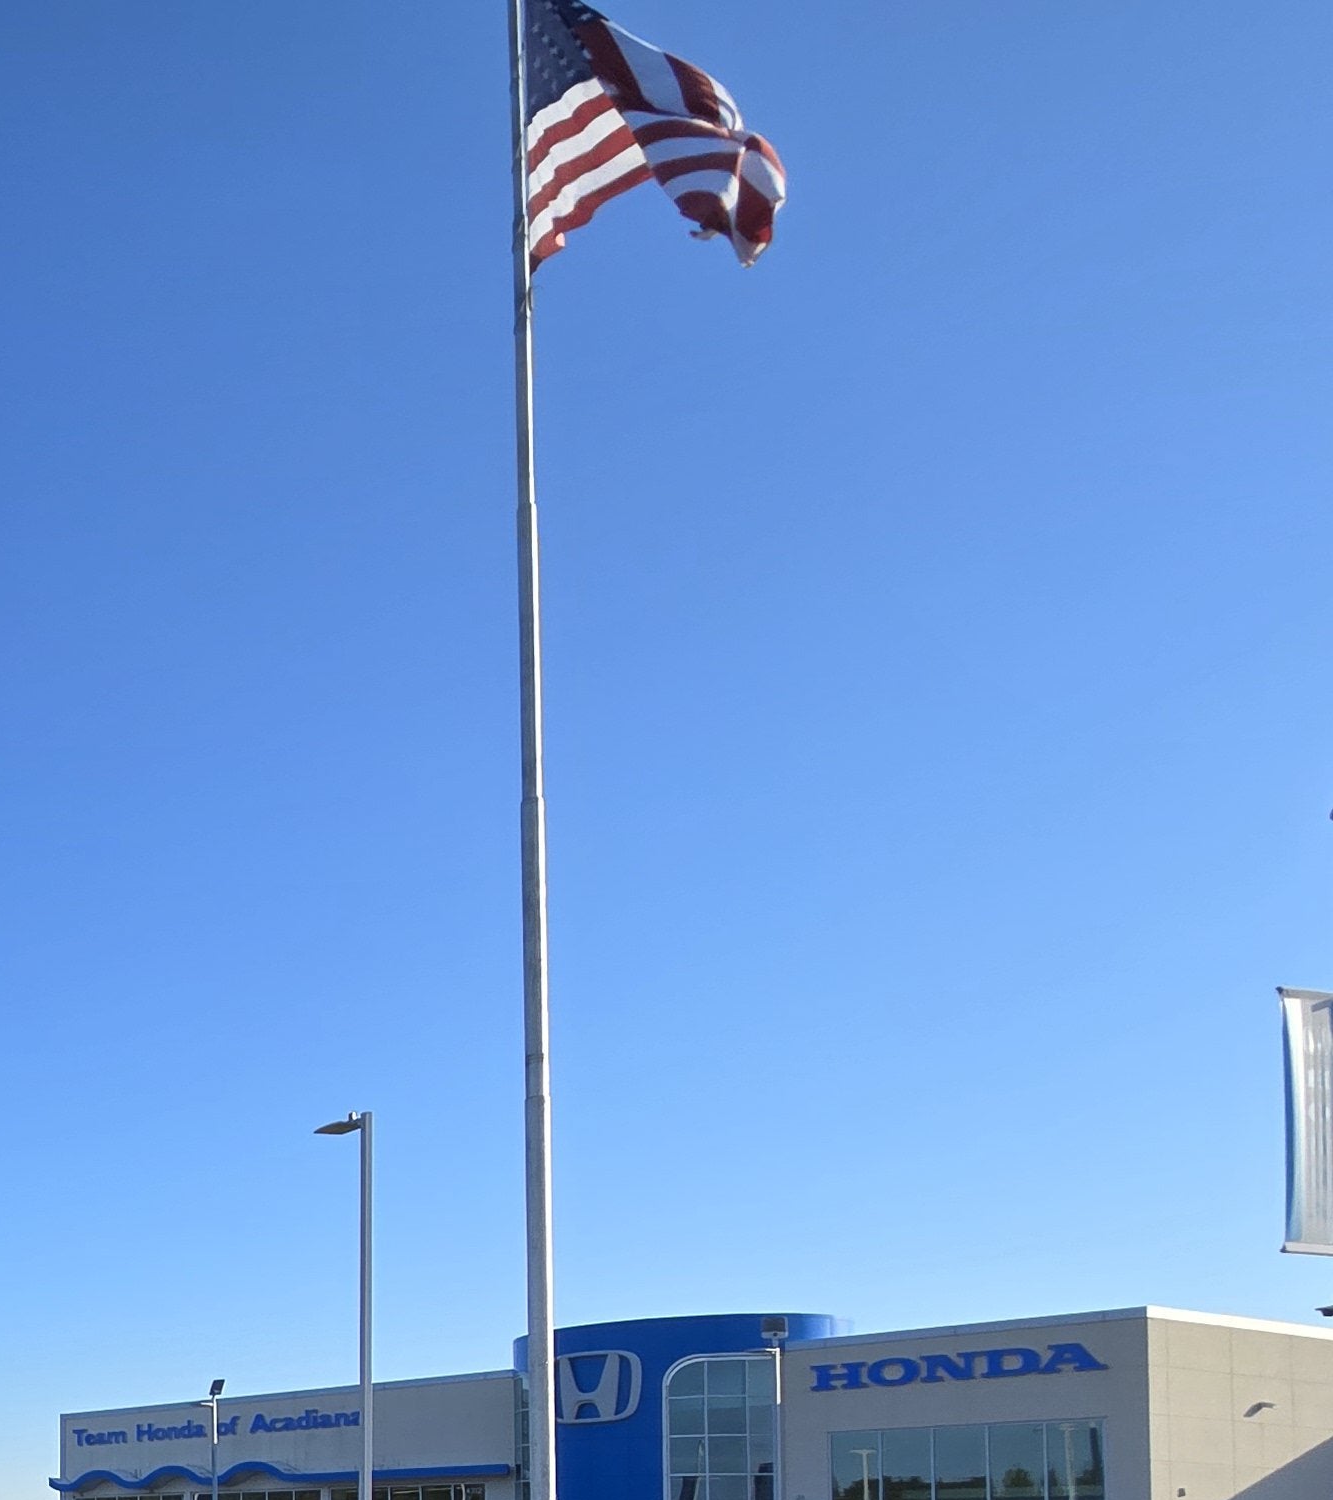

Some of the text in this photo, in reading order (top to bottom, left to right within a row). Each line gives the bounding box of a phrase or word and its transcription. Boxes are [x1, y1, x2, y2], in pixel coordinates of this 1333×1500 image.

[810, 1343, 1109, 1391] HONDA
[73, 1428, 128, 1446] Team
[136, 1420, 207, 1442] Honda
[218, 1416, 241, 1436] of
